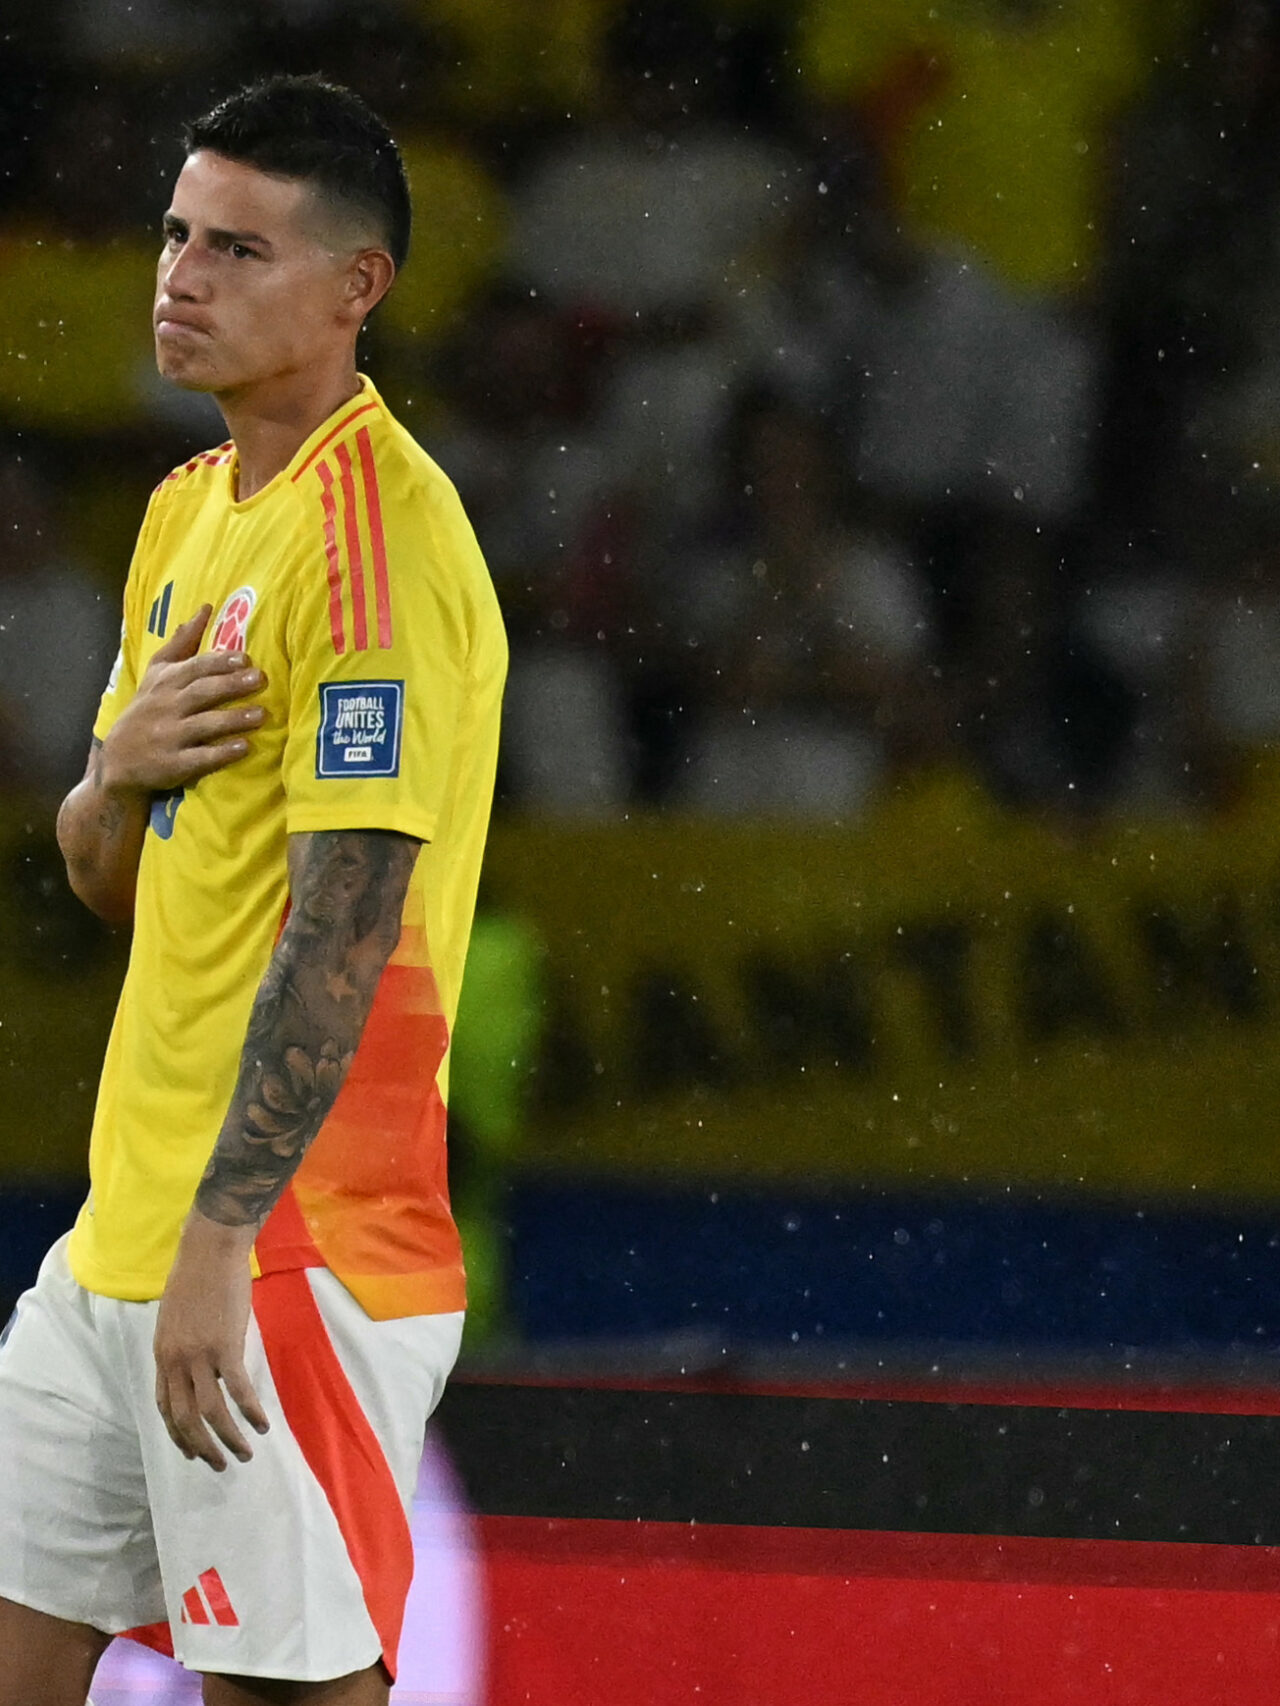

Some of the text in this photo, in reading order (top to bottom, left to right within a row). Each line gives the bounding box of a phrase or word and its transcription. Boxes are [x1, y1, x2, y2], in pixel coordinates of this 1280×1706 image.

[338, 697, 384, 711] FOOTBALL
[335, 711, 384, 728] UNITES
[332, 728, 387, 745] the World
[348, 750, 367, 758] FIFA
